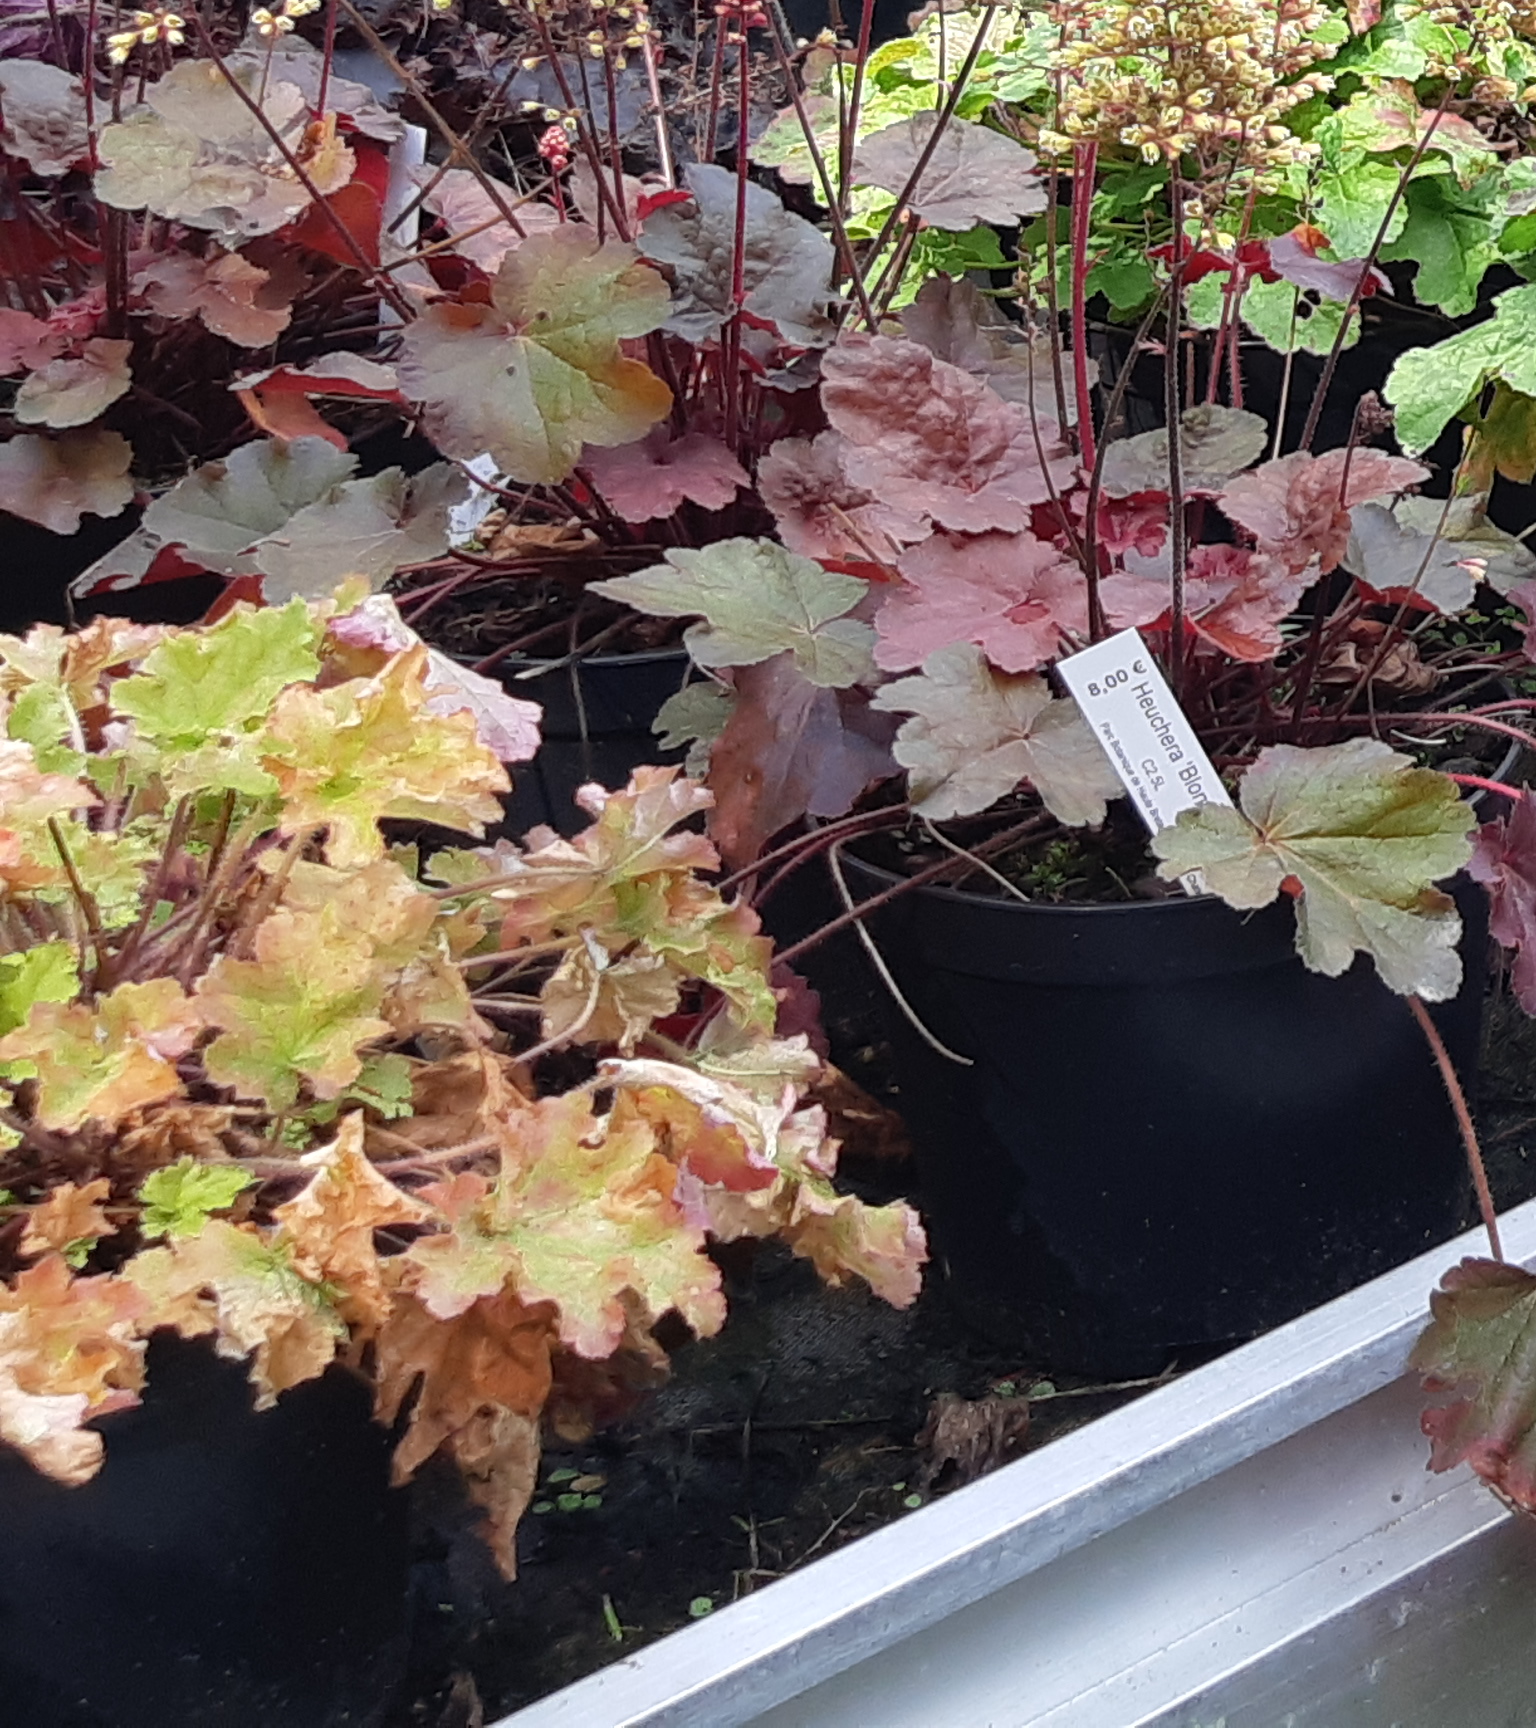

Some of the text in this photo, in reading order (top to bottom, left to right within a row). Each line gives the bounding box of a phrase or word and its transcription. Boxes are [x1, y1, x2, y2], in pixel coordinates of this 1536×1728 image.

[1087, 659, 1148, 697] 8,00 €
[1131, 680, 1185, 763] Heuchera
